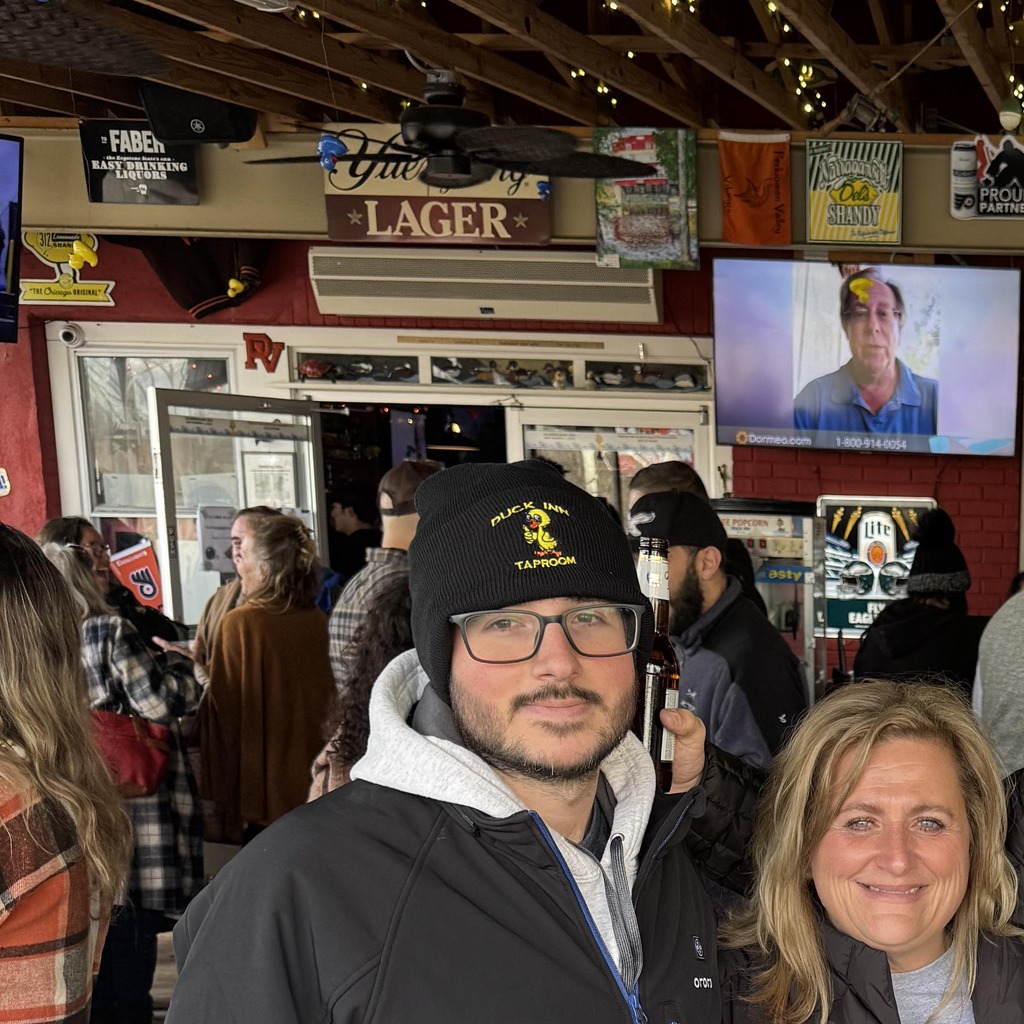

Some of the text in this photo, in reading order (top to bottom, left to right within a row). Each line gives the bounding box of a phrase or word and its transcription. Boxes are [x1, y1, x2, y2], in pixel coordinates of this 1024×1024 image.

[91, 160, 188, 172] EASY DRINKING
[115, 170, 168, 180] LIQUORS
[365, 200, 512, 239] LAGER
[827, 204, 882, 226] SHANDY
[44, 287, 72, 298] Chicago
[490, 501, 570, 528] DUCK INN
[732, 518, 769, 527] POPCORN
[864, 520, 891, 539] Lite
[514, 555, 577, 571] TAPROOM
[769, 569, 803, 582] asty
